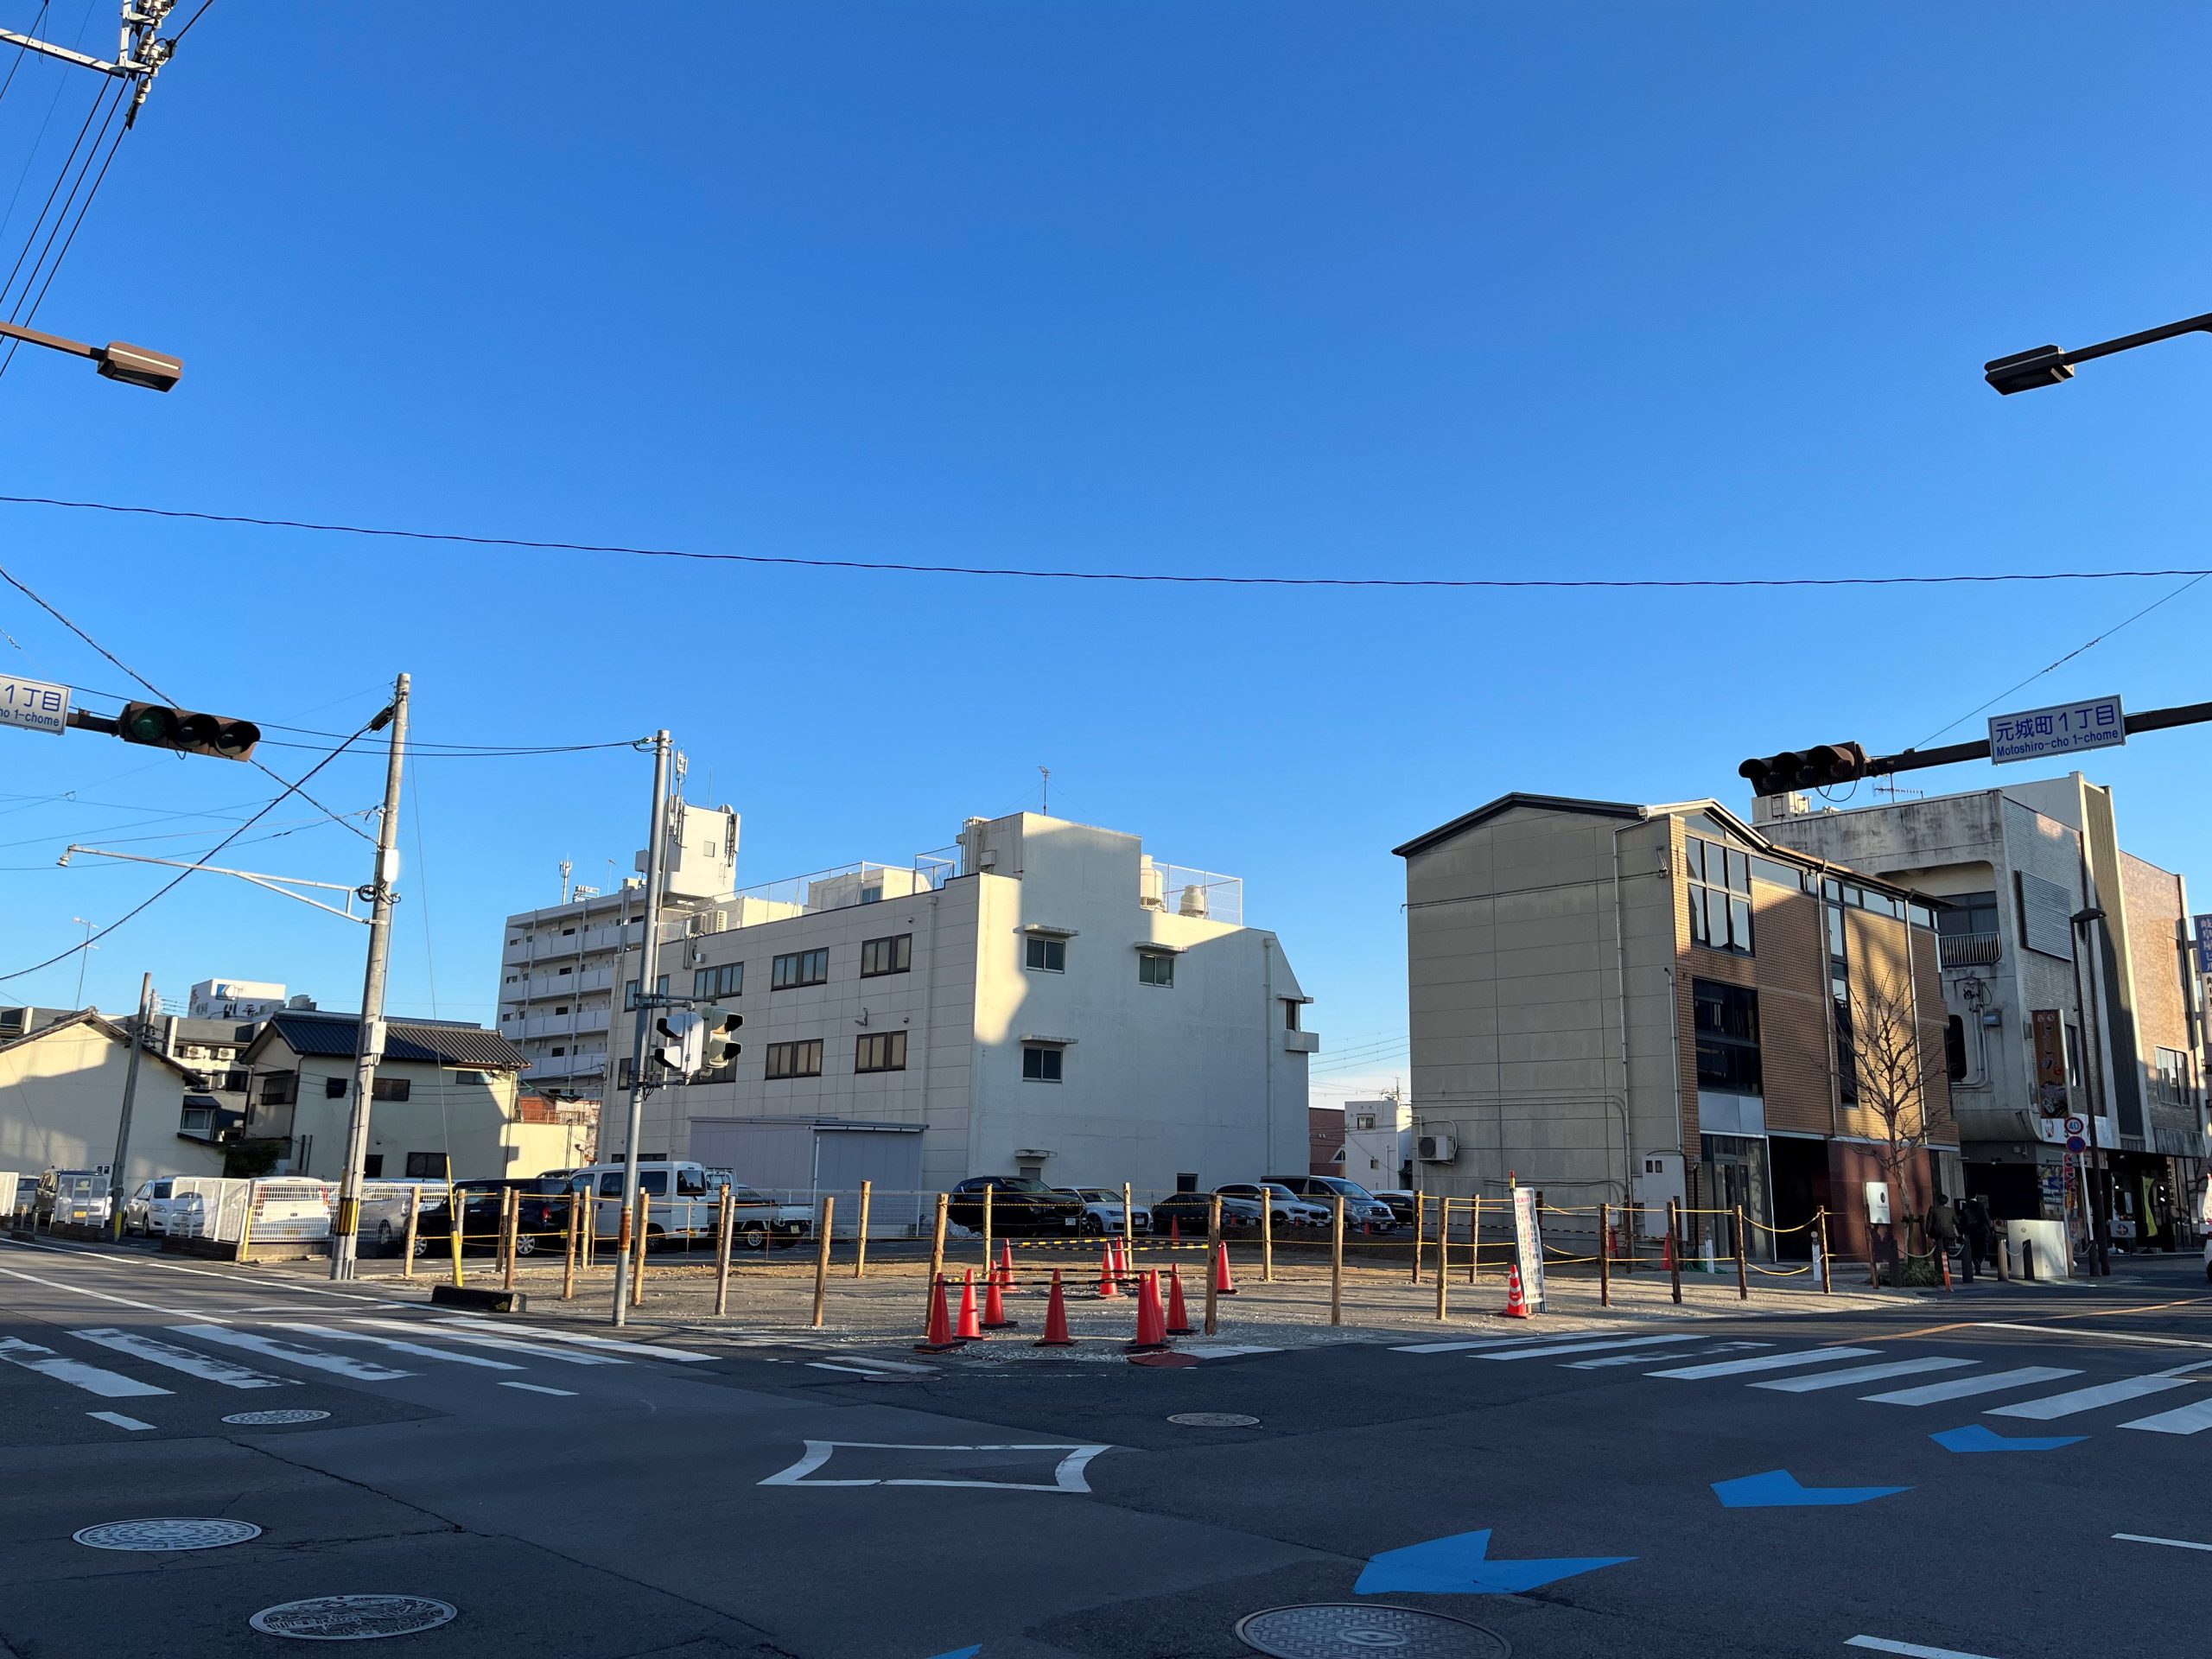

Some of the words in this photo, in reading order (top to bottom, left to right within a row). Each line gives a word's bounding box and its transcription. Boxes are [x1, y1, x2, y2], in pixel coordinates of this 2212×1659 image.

[0, 683, 61, 712] 1丁目
[14, 709, 60, 727] 1-chome
[1996, 704, 2115, 742] 元城町1丁目
[1996, 738, 2069, 757] Motoshiro-cho
[2072, 729, 2119, 744] 1-chome
[2069, 1122, 2080, 1130] 40
